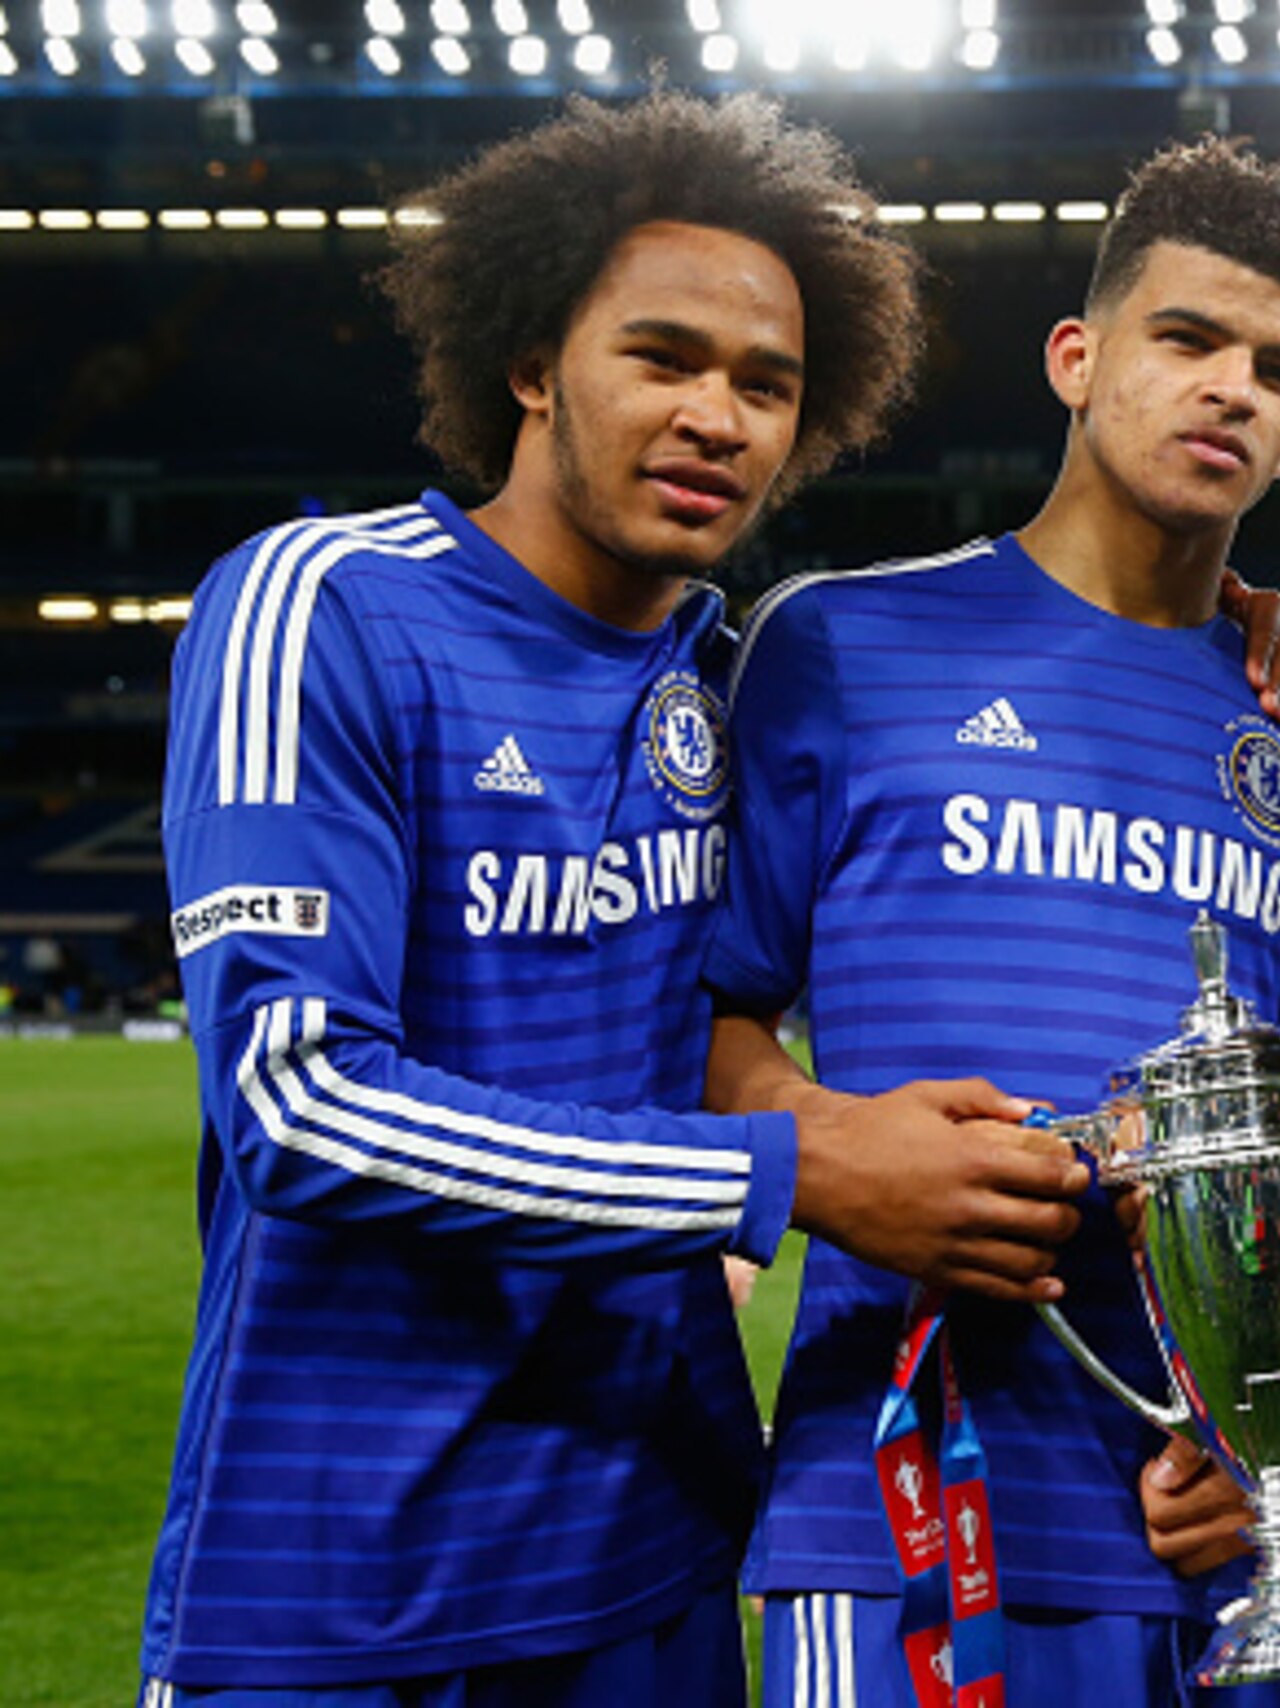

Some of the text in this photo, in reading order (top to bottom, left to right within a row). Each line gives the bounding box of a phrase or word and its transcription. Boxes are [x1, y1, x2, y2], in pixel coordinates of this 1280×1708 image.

[956, 724, 1038, 752] adidas
[473, 769, 545, 796] adidas
[175, 891, 281, 942] Respect
